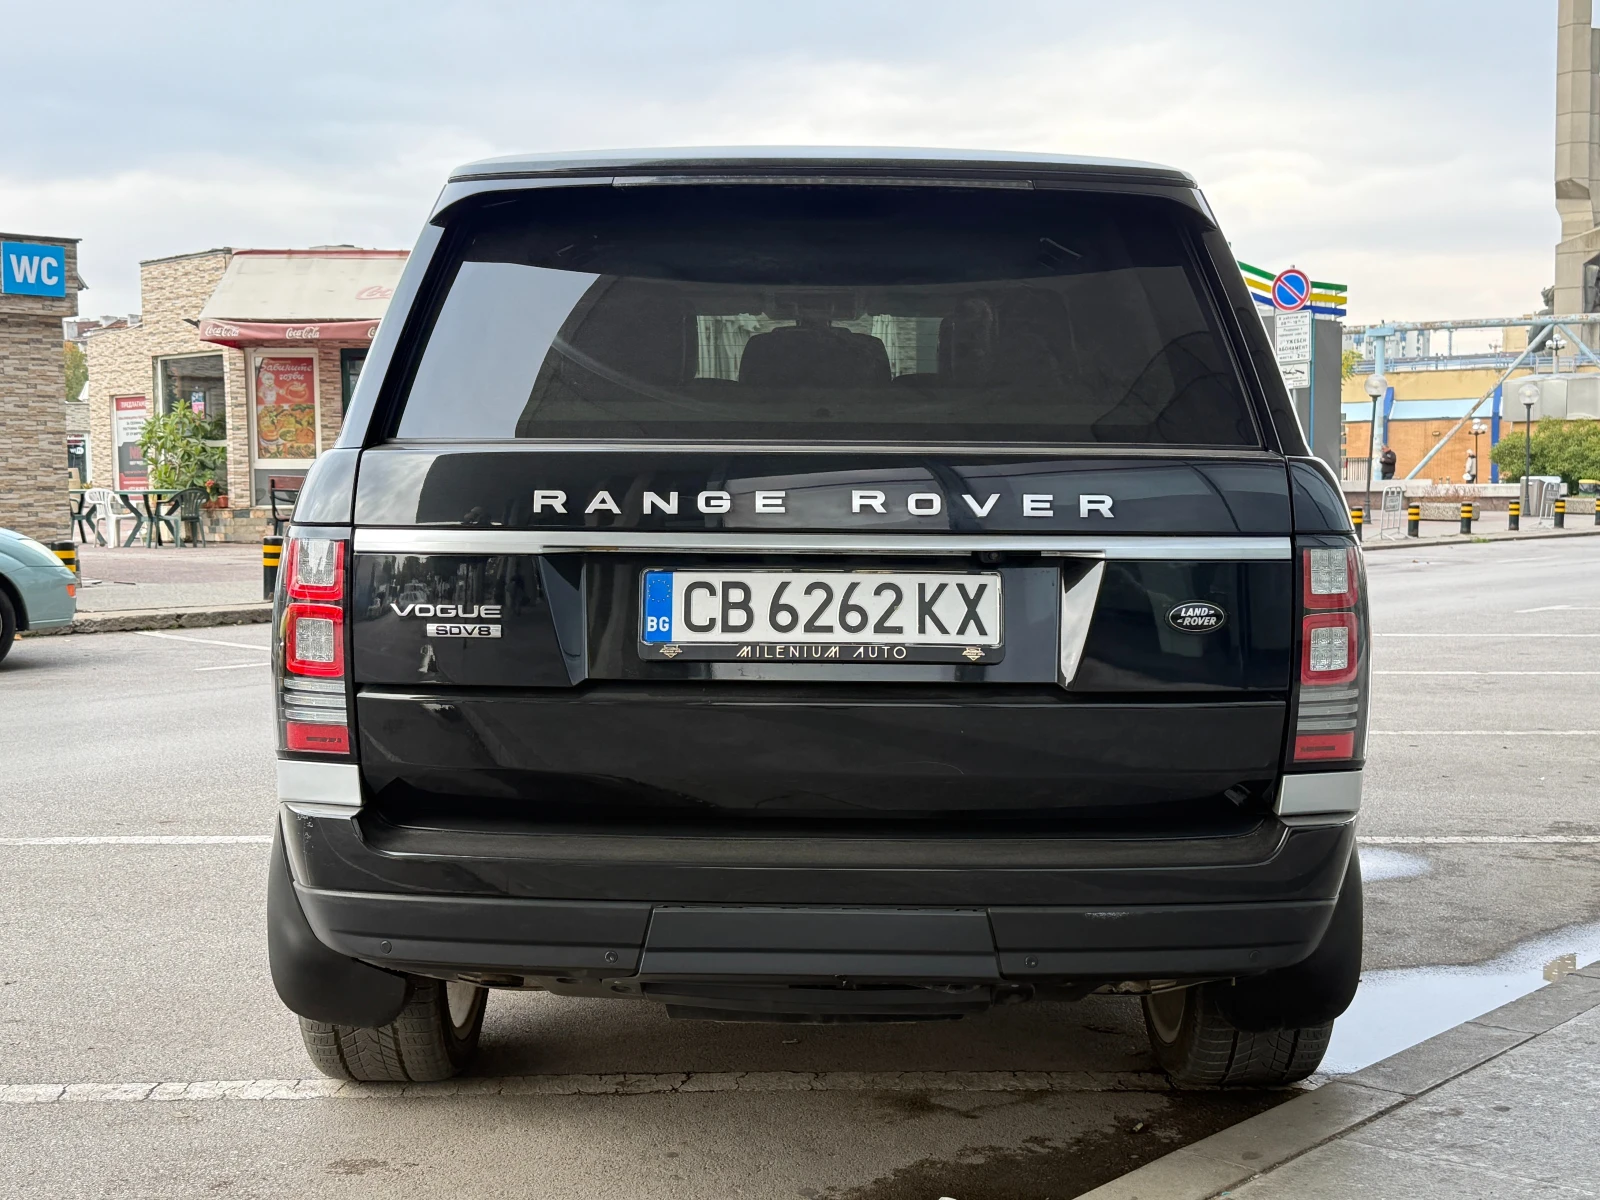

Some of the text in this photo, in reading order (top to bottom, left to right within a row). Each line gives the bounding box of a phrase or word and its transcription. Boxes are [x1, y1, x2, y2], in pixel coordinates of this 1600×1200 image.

[9, 253, 59, 286] WC
[204, 325, 240, 338] Coca-Cola
[285, 326, 320, 339] Coca-Cola
[533, 490, 1114, 518] RANGE ROVER
[389, 603, 502, 618] VOGUE
[768, 581, 904, 635] 6262
[435, 625, 492, 636] SDV8
[647, 616, 671, 632] BG
[736, 645, 907, 659] MILENIUM AUTO
